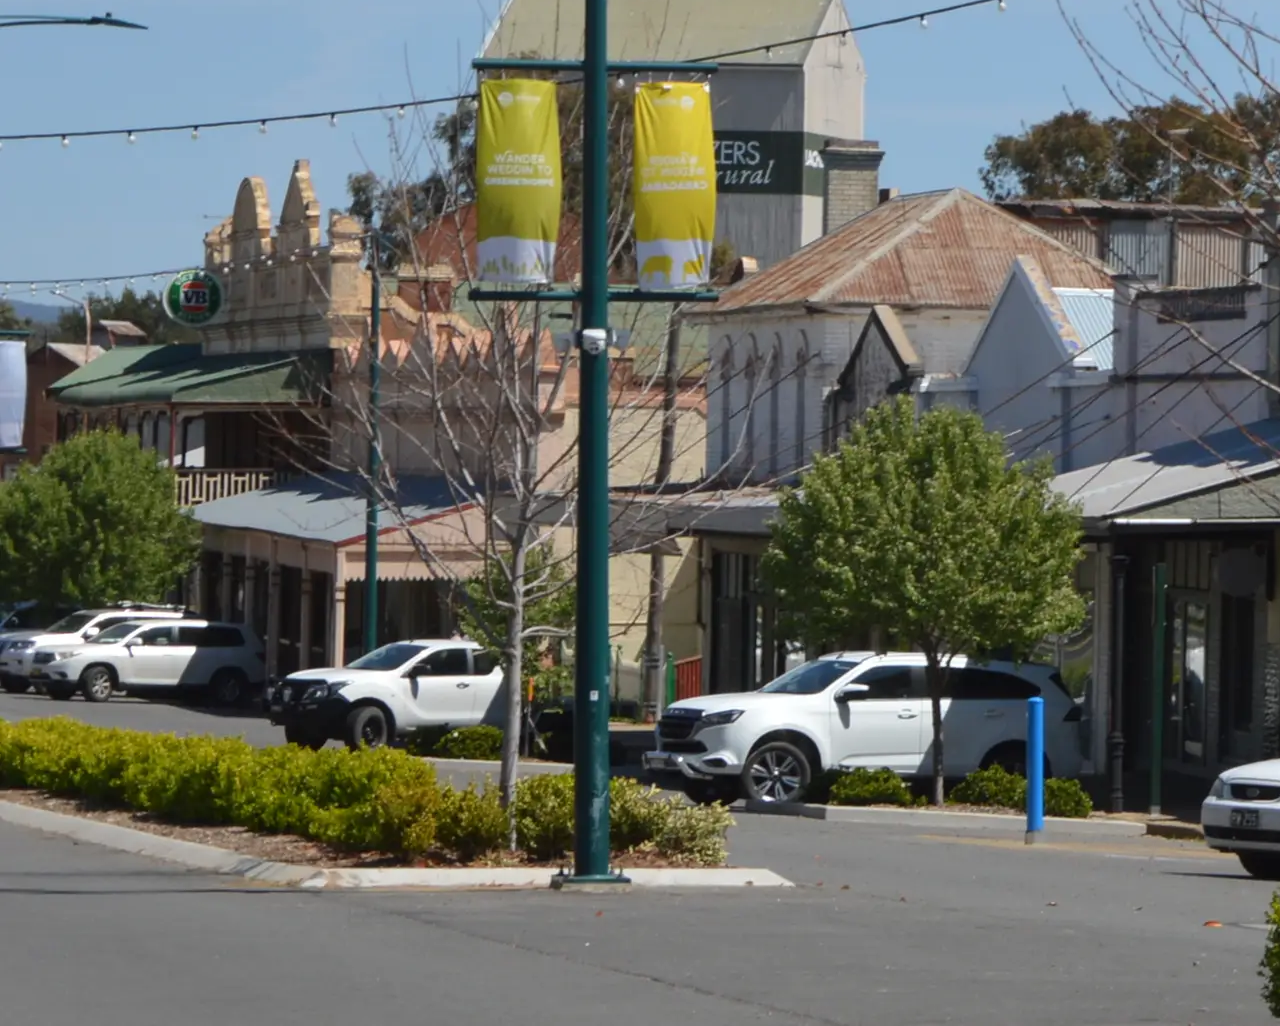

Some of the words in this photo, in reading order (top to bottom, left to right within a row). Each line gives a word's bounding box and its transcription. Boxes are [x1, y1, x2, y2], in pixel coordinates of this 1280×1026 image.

[494, 151, 546, 165] WANDER
[487, 164, 534, 175] WEDDIN
[538, 164, 553, 176] TO
[183, 289, 208, 304] VB
